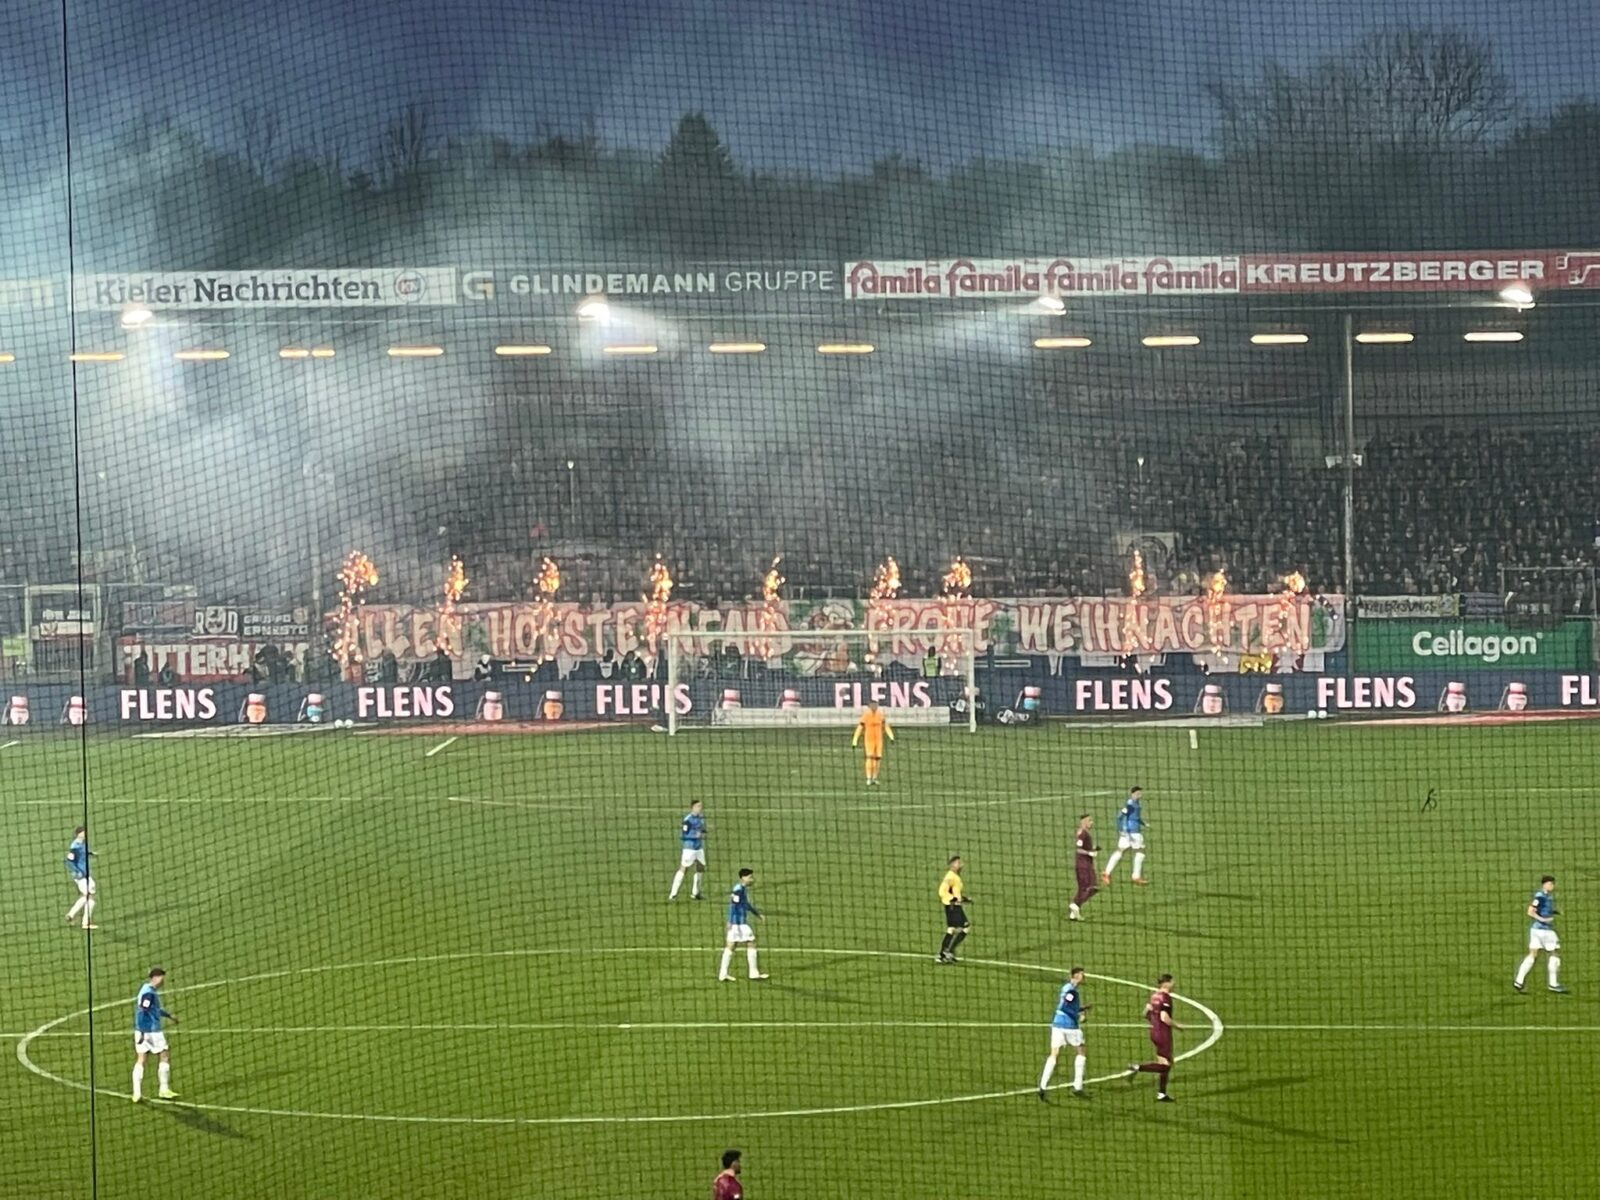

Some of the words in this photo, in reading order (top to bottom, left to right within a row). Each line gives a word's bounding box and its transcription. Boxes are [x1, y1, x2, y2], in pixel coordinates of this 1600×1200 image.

[510, 272, 716, 296] GLINDEMANN
[724, 270, 835, 292] GRUPPE
[846, 260, 941, 298] famila
[945, 259, 1040, 297] famila
[1043, 258, 1139, 297] famila
[1142, 257, 1238, 295] famila
[1246, 260, 1545, 285] KREUTZBERGER
[95, 278, 186, 305] Kieler
[193, 275, 381, 303] Nachrichten
[1017, 600, 1312, 652] WEIHNACHTEN
[1412, 630, 1537, 663] Cellagon
[120, 688, 217, 720] FLENS
[357, 685, 455, 718] FLENS
[596, 683, 693, 715] FLENS
[1075, 678, 1173, 711] FLENS
[1317, 676, 1417, 709] FLENS
[1561, 674, 1600, 706] FL
